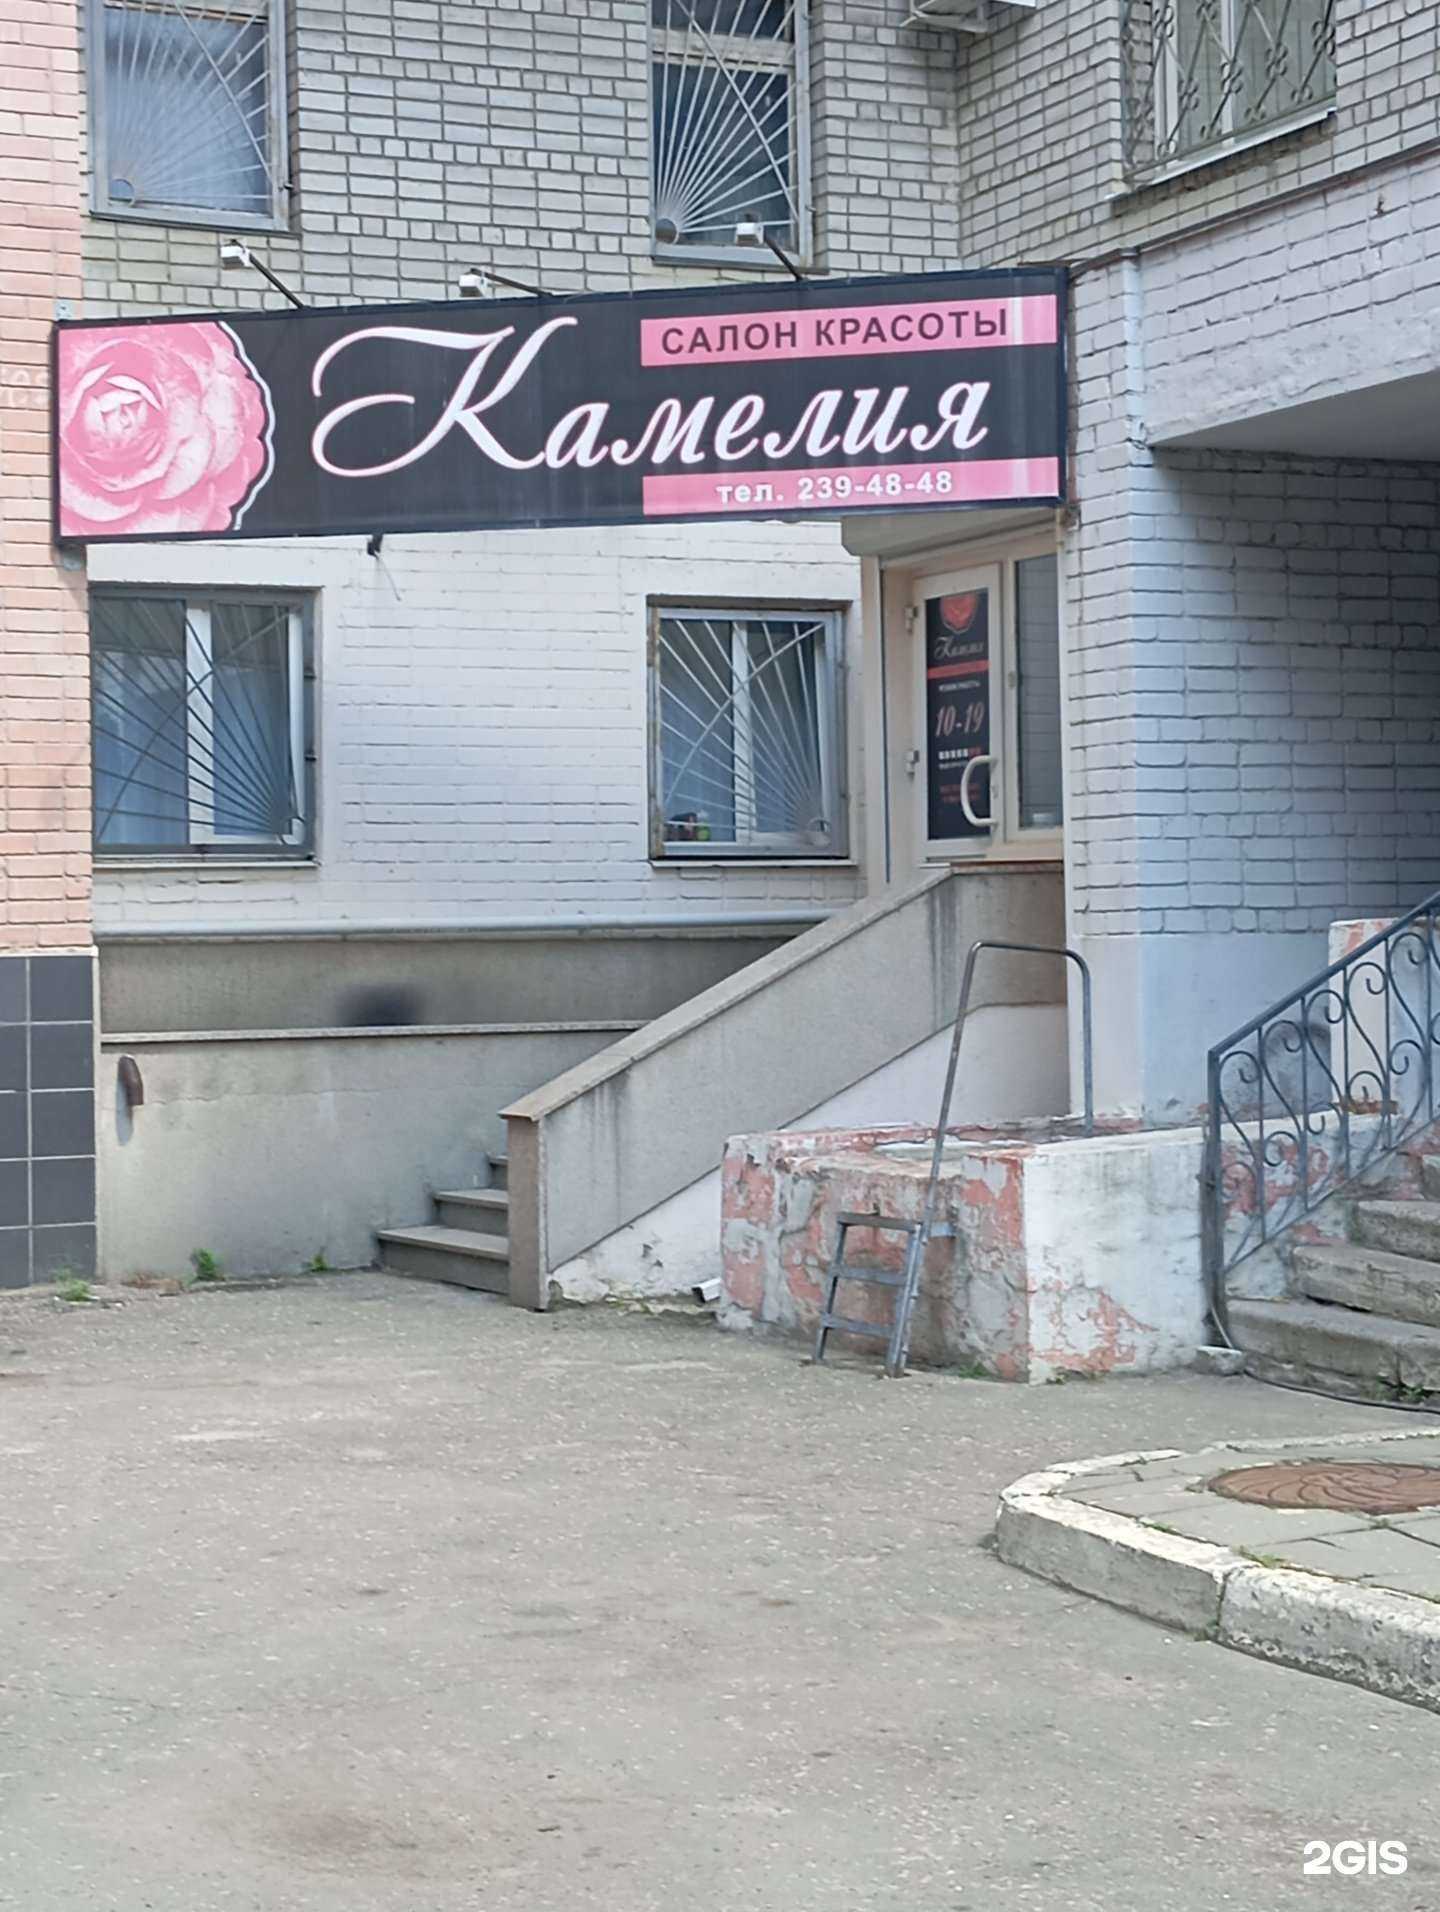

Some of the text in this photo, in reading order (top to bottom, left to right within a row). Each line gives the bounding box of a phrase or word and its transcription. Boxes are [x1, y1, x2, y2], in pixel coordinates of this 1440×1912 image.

[661, 308, 1008, 356] САЛОН КРАСОТЫ
[311, 316, 990, 478] Камелия
[715, 471, 954, 505] тел. 239-48-48
[936, 701, 985, 737] 10-19
